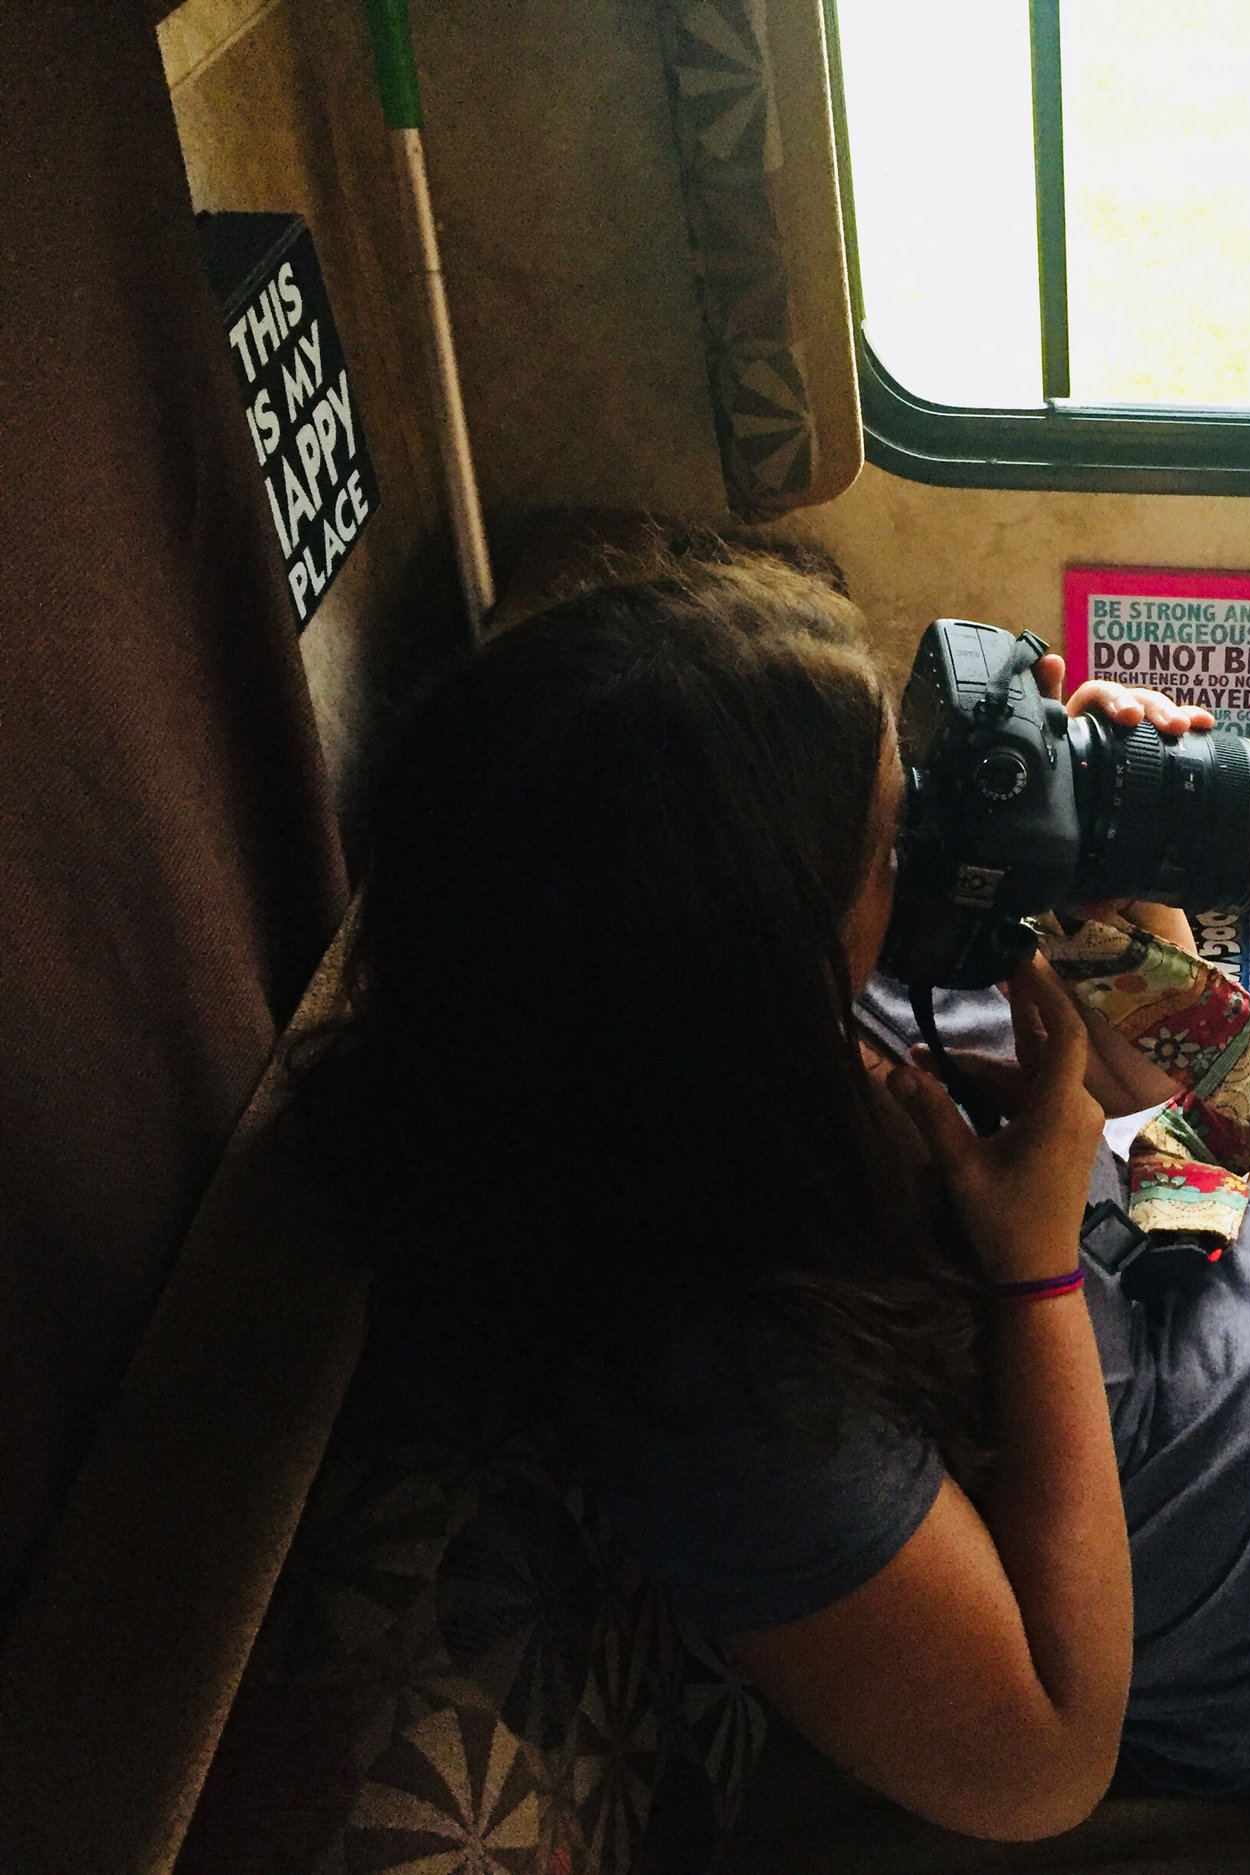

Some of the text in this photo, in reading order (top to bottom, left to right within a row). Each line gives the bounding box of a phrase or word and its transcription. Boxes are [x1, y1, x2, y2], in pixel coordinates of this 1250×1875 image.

[229, 261, 303, 383] THIS
[246, 319, 322, 467] IS MY
[288, 469, 369, 621] PLACE
[1093, 600, 1121, 619] BE
[1129, 601, 1216, 622] STRONG
[1093, 642, 1140, 670] DO
[1149, 644, 1216, 673] NOT
[1193, 674, 1204, 686] &
[1208, 674, 1229, 687] DO
[1195, 911, 1241, 956] DOG
